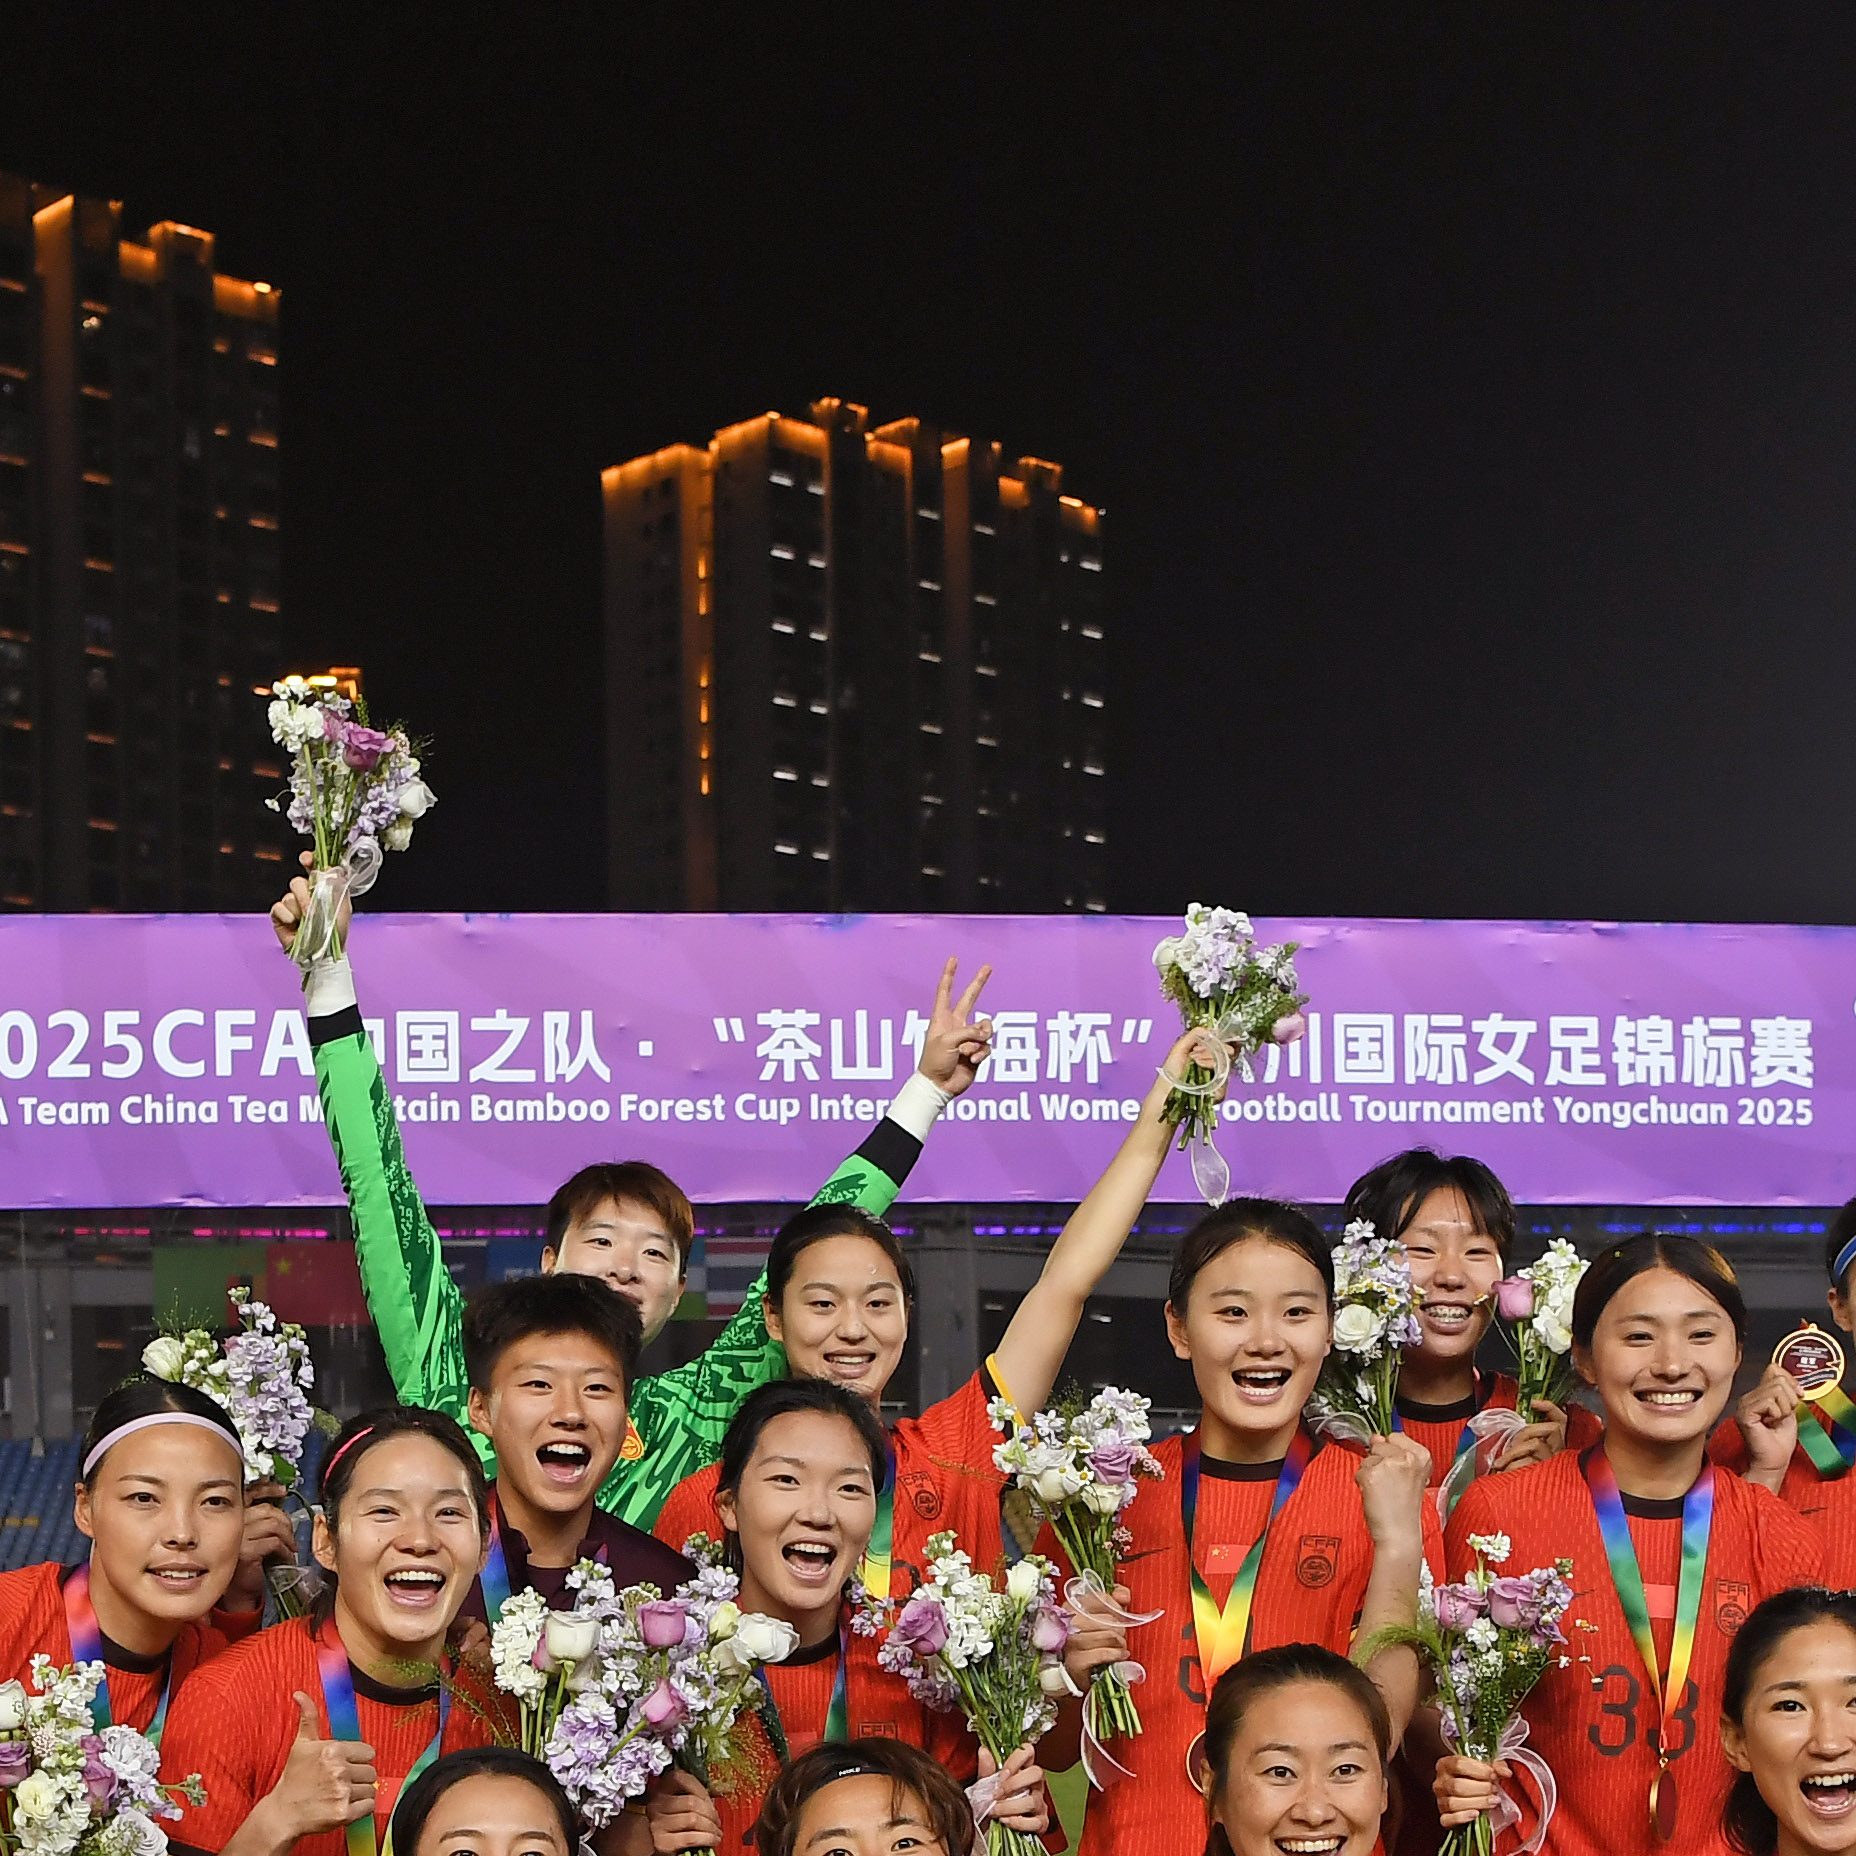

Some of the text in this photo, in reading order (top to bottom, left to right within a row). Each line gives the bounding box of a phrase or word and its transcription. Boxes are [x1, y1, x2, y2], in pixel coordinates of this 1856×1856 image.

[17, 1097, 110, 1125] Team
[120, 1093, 218, 1124] China
[227, 1095, 289, 1123] Tea
[299, 1091, 460, 1124] Mtain
[470, 1091, 610, 1122] Bamboo
[620, 1093, 726, 1121] Forest
[734, 1093, 801, 1126] Cup
[810, 1091, 1032, 1121] Interional
[1212, 1093, 1342, 1122] ootball
[1348, 1095, 1545, 1123] Tournament
[1552, 1095, 1729, 1129] Yongchuan
[1737, 1098, 1813, 1126] 2025
[1588, 1664, 1700, 1761] 33
